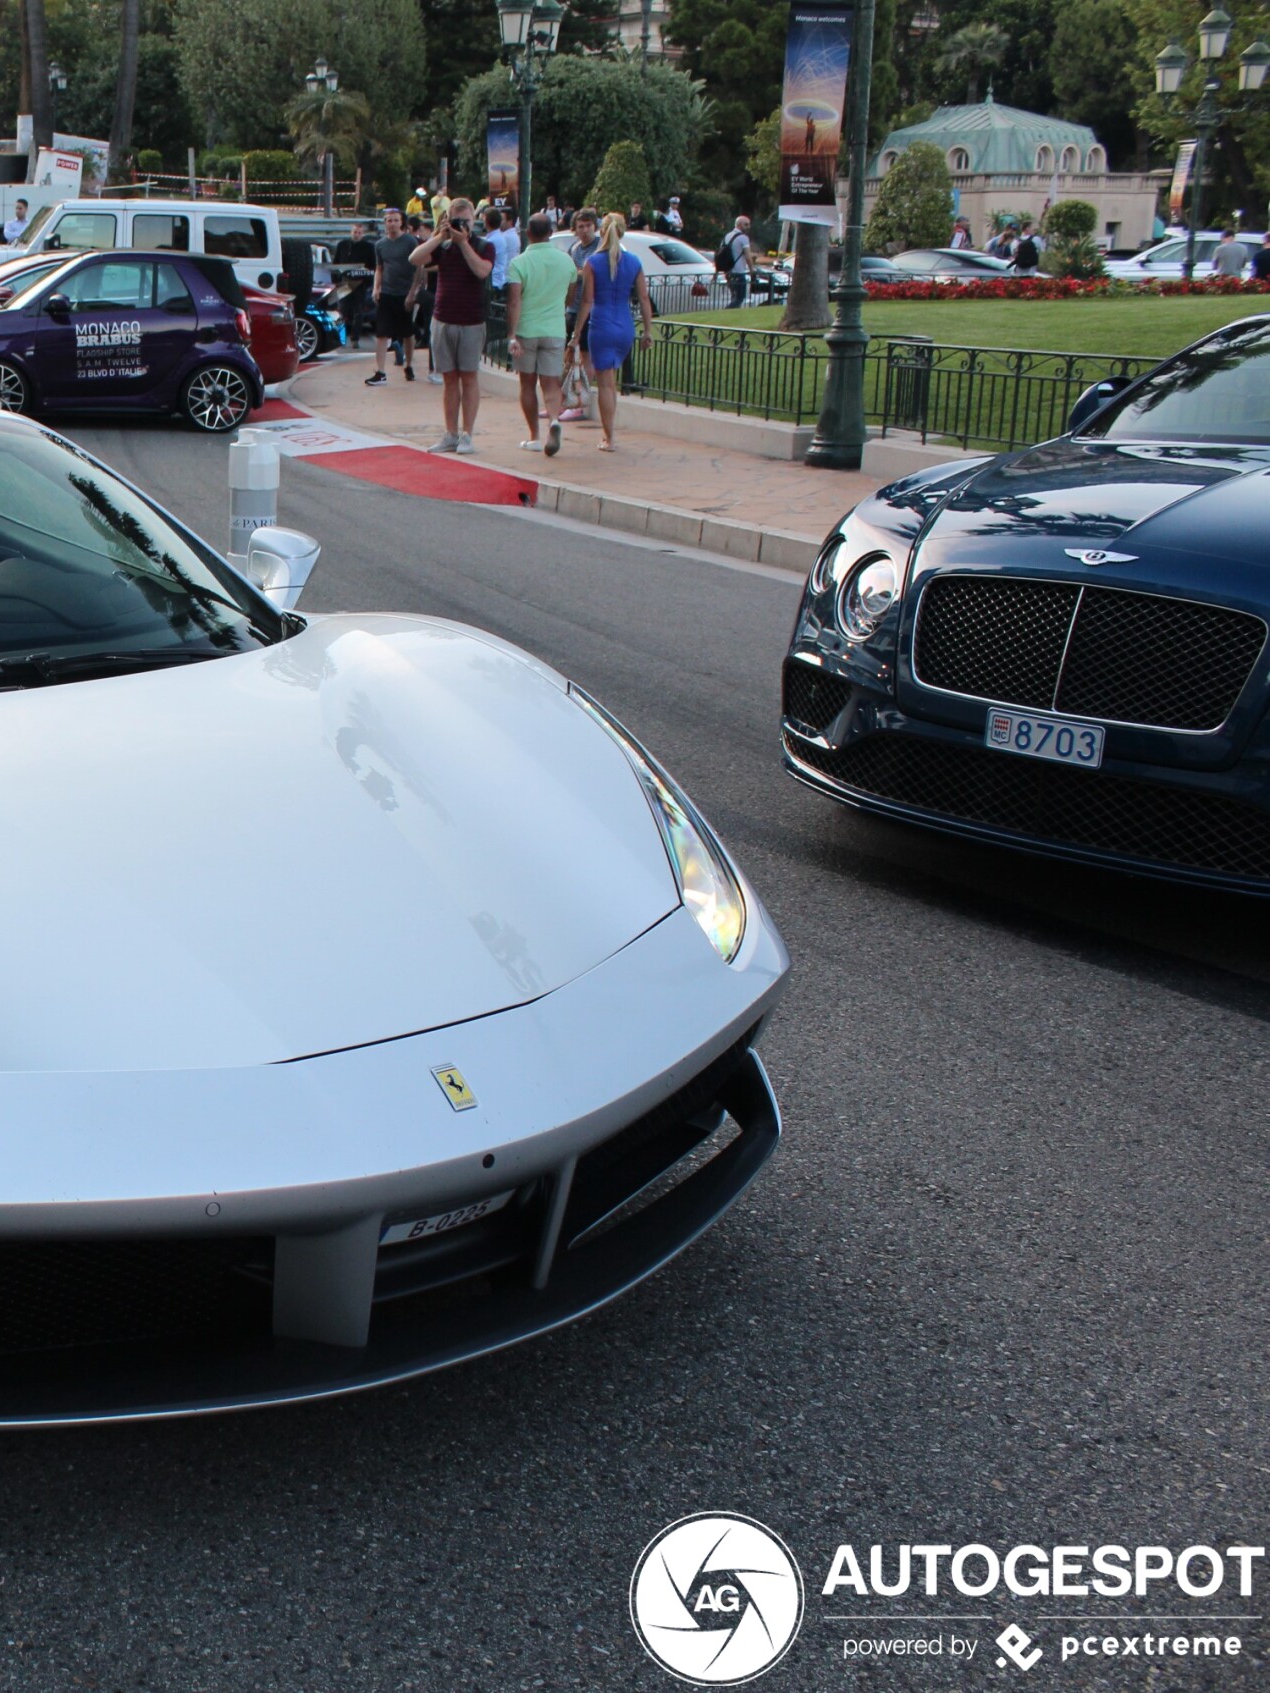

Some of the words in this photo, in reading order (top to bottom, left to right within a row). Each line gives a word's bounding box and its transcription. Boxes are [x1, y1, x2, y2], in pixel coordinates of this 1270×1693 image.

[494, 198, 507, 206] EY
[75, 321, 141, 336] MONACO
[76, 333, 143, 347] BRABUS
[76, 349, 115, 358] FLAGSHIP
[116, 347, 141, 356] STORE
[106, 357, 142, 367] TWELVE
[77, 370, 87, 378] 23
[88, 368, 108, 378] BLVD
[994, 731, 1007, 740] MC
[1014, 720, 1096, 761] 8703
